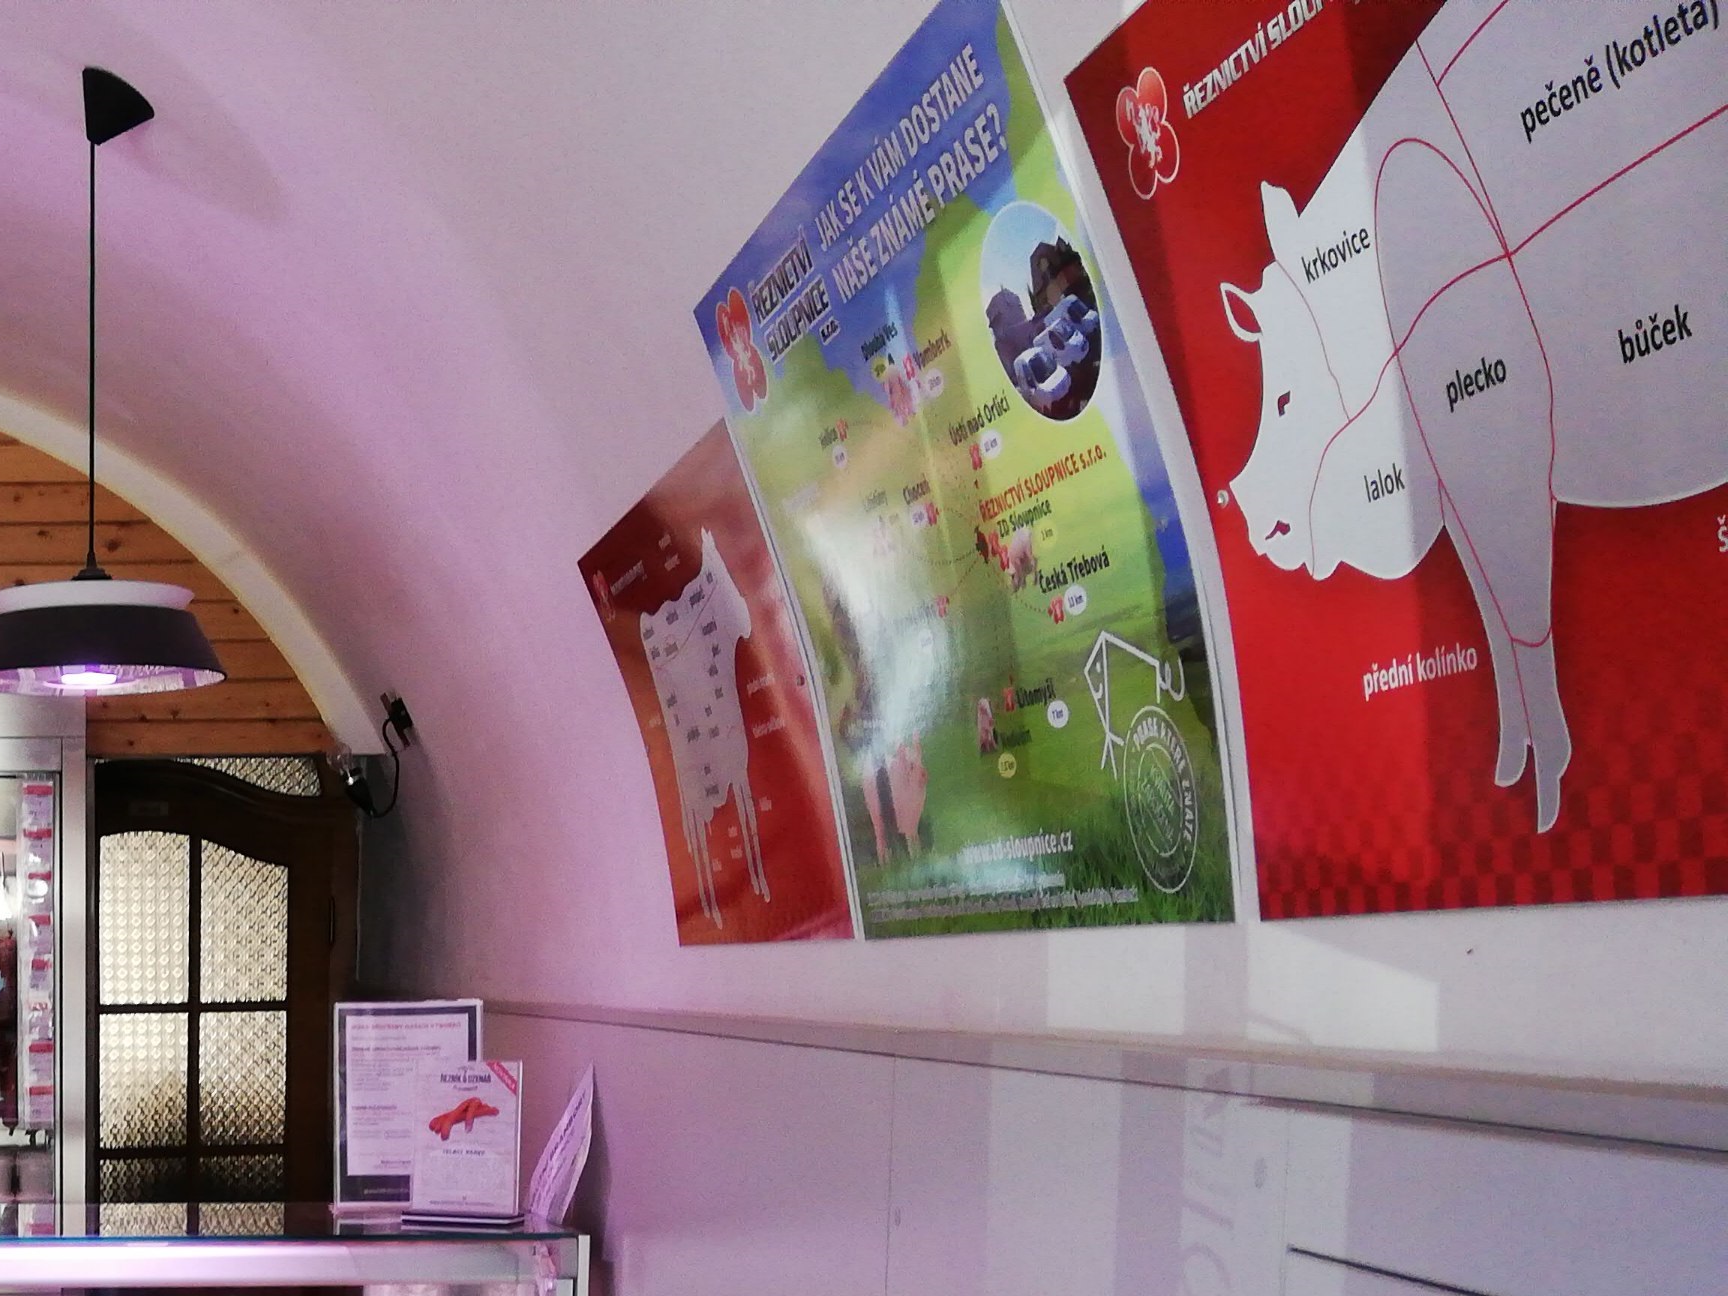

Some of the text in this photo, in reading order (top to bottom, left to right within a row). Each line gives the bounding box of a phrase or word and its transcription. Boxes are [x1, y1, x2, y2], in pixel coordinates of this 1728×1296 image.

[1183, 22, 1268, 119] ŘEZNICTVÍ
[1520, 0, 1719, 144] pečeně (kotleta)
[814, 43, 985, 252] JAK SE K VÁM DOSTANE
[831, 102, 1008, 304] NAŠE ZNÁMÉ PRASE?
[1301, 227, 1371, 284] krkovice
[1618, 304, 1692, 364] bůček
[1445, 357, 1507, 413] plecko
[1025, 453, 1080, 499] SLOUPNICE
[1079, 444, 1107, 470] s.r.o.
[1364, 463, 1405, 503] lalok
[1038, 545, 1111, 595] Česká Třebová
[1363, 643, 1479, 702] přední kolínko
